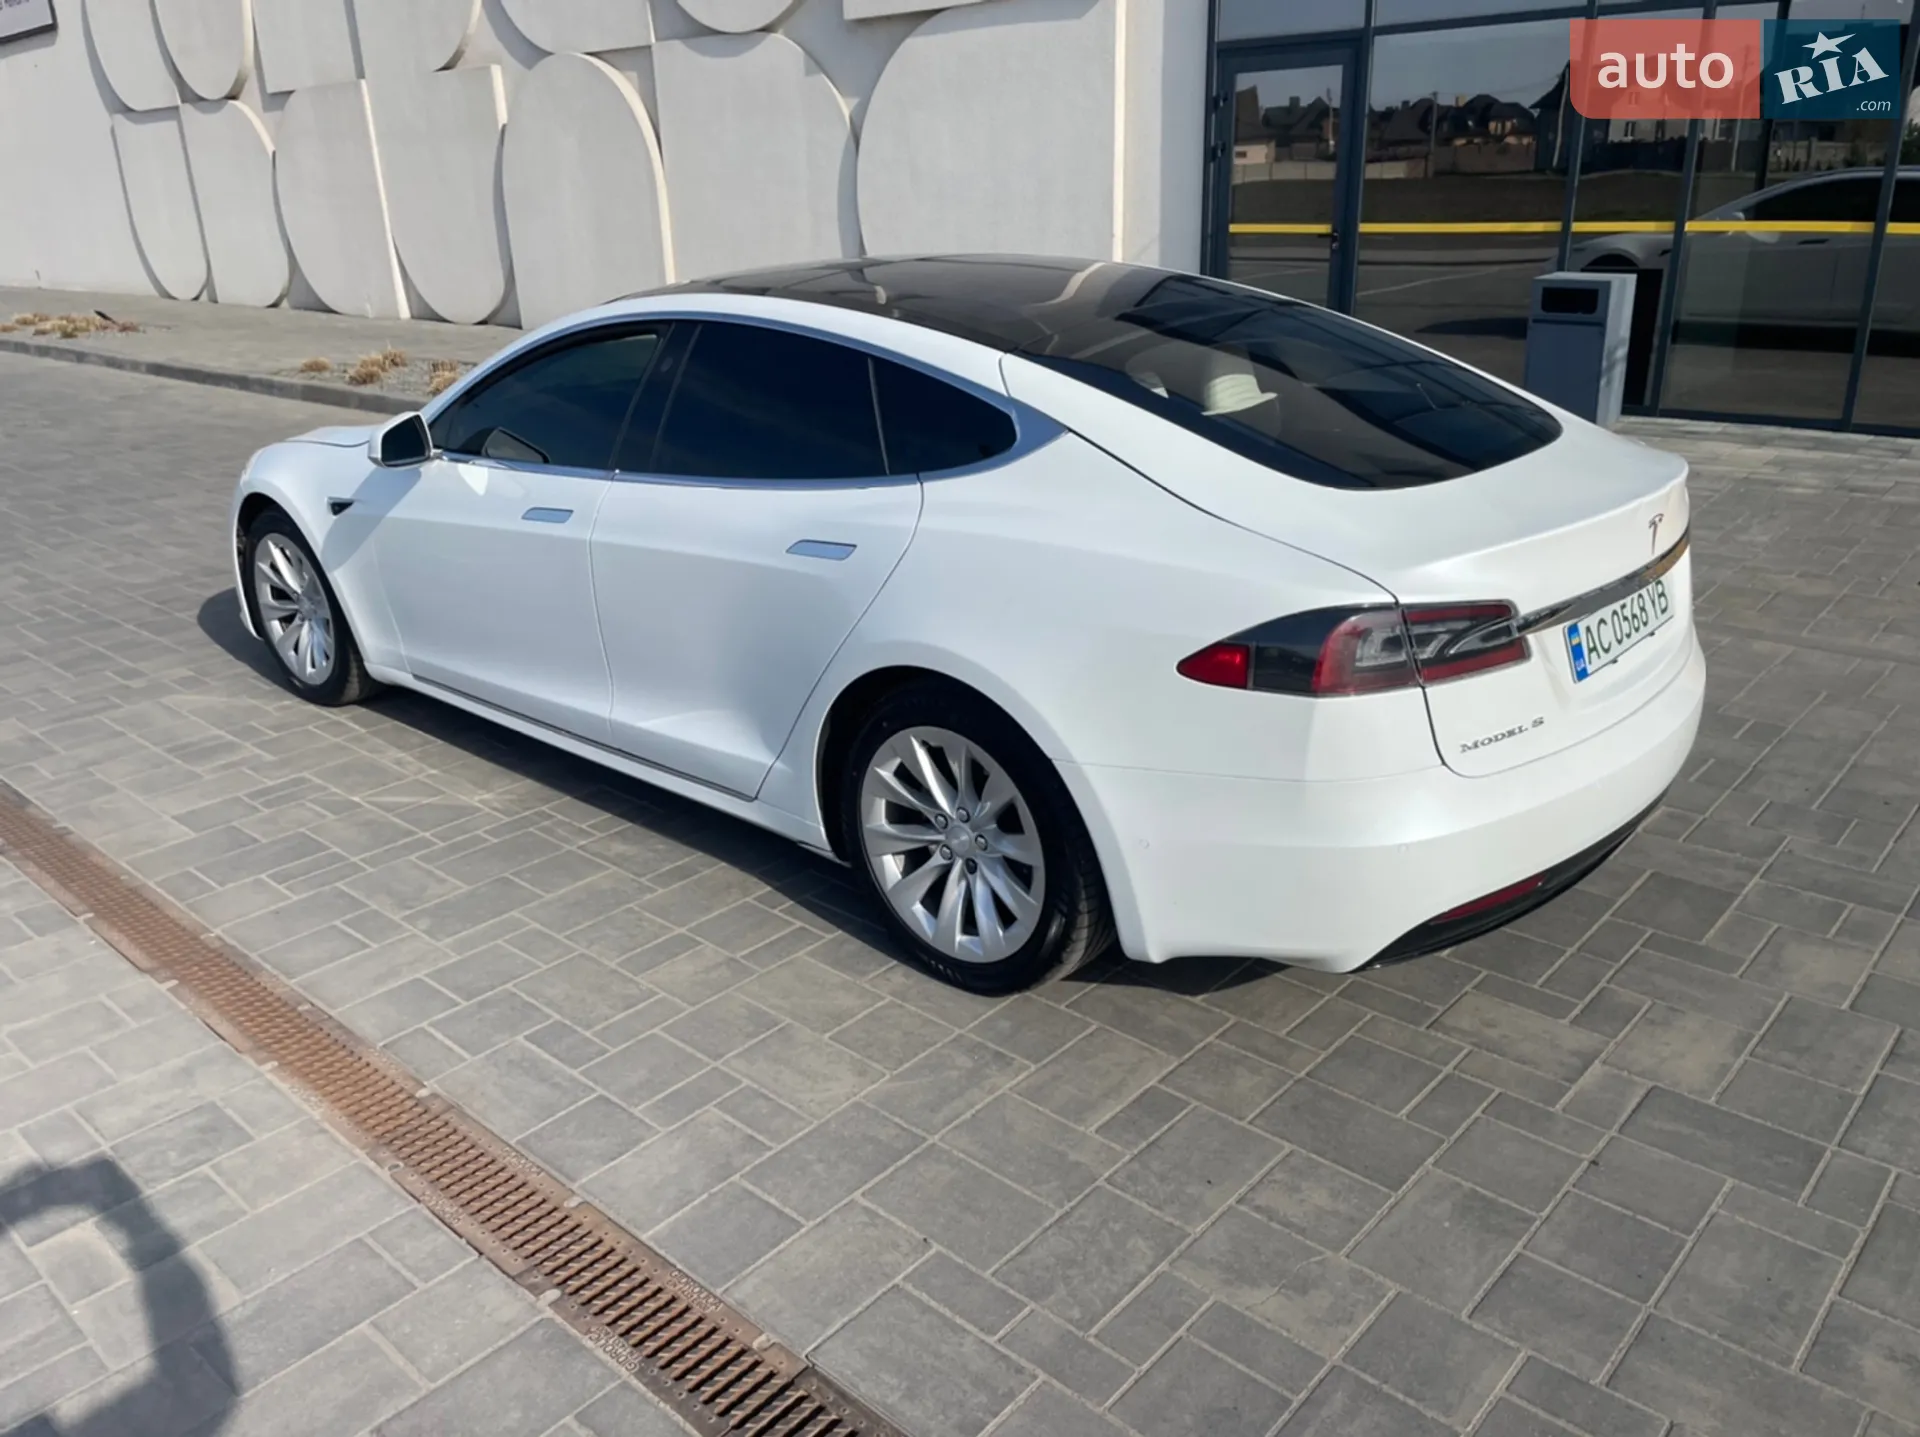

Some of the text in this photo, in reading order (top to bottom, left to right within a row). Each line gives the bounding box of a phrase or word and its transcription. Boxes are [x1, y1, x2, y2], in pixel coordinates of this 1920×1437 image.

[1585, 579, 1669, 665] AC 0568 YB
[1460, 716, 1544, 754] MODEL S
